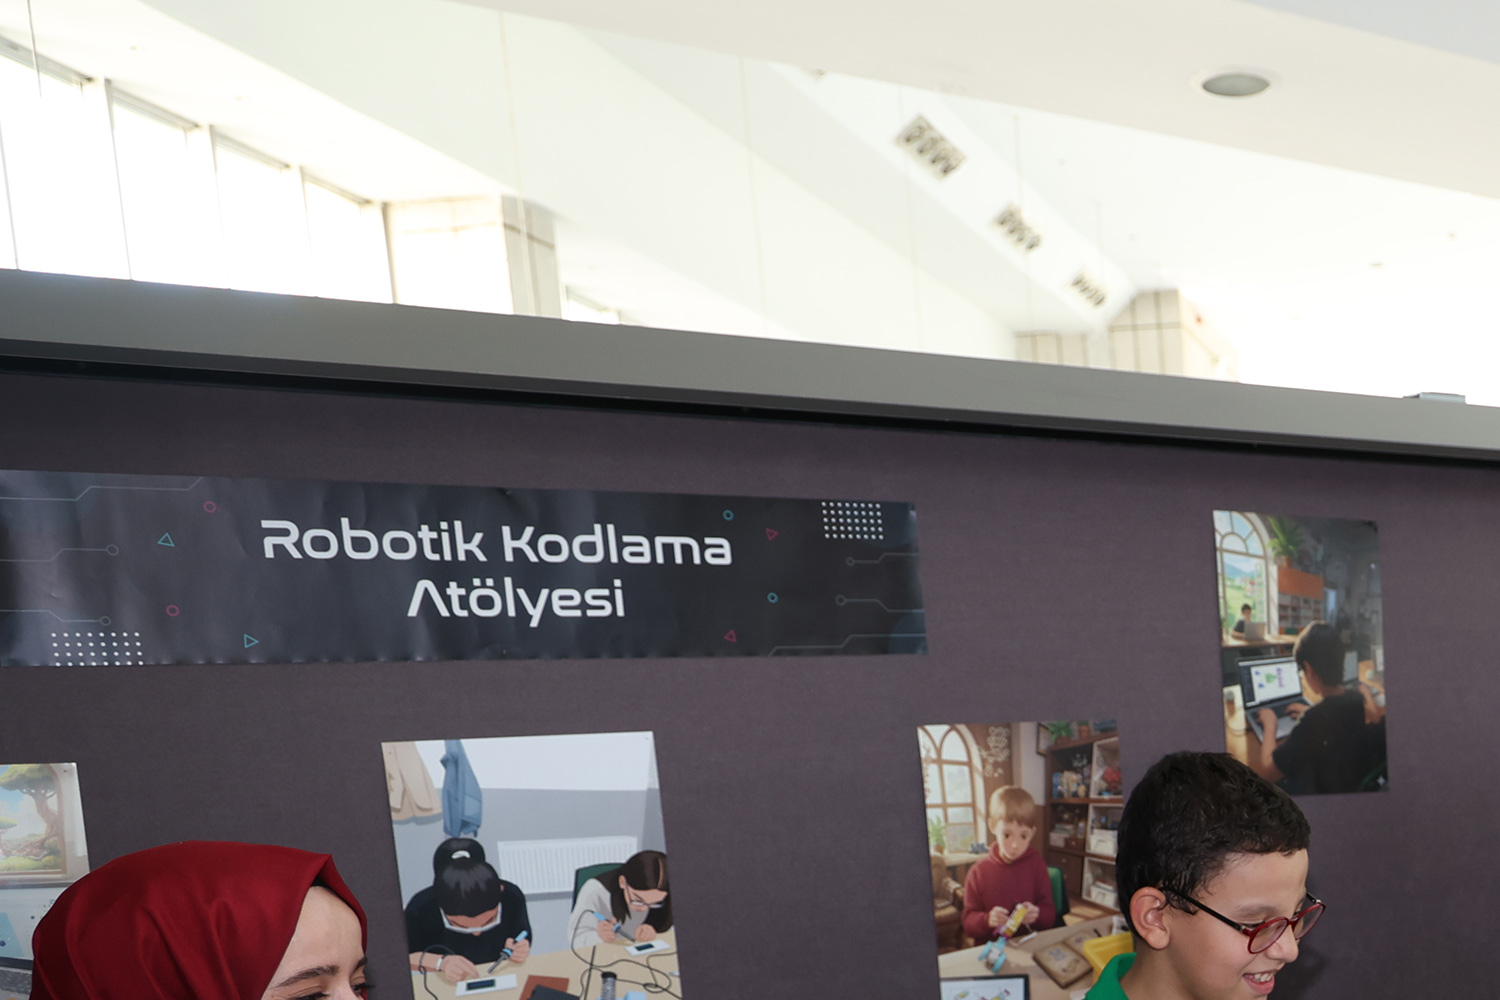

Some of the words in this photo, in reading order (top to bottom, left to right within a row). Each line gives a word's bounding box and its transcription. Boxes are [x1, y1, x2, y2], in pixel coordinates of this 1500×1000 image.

[261, 518, 487, 561] Robotik
[502, 524, 731, 565] Kodlama
[407, 577, 624, 627] Atölyesi
